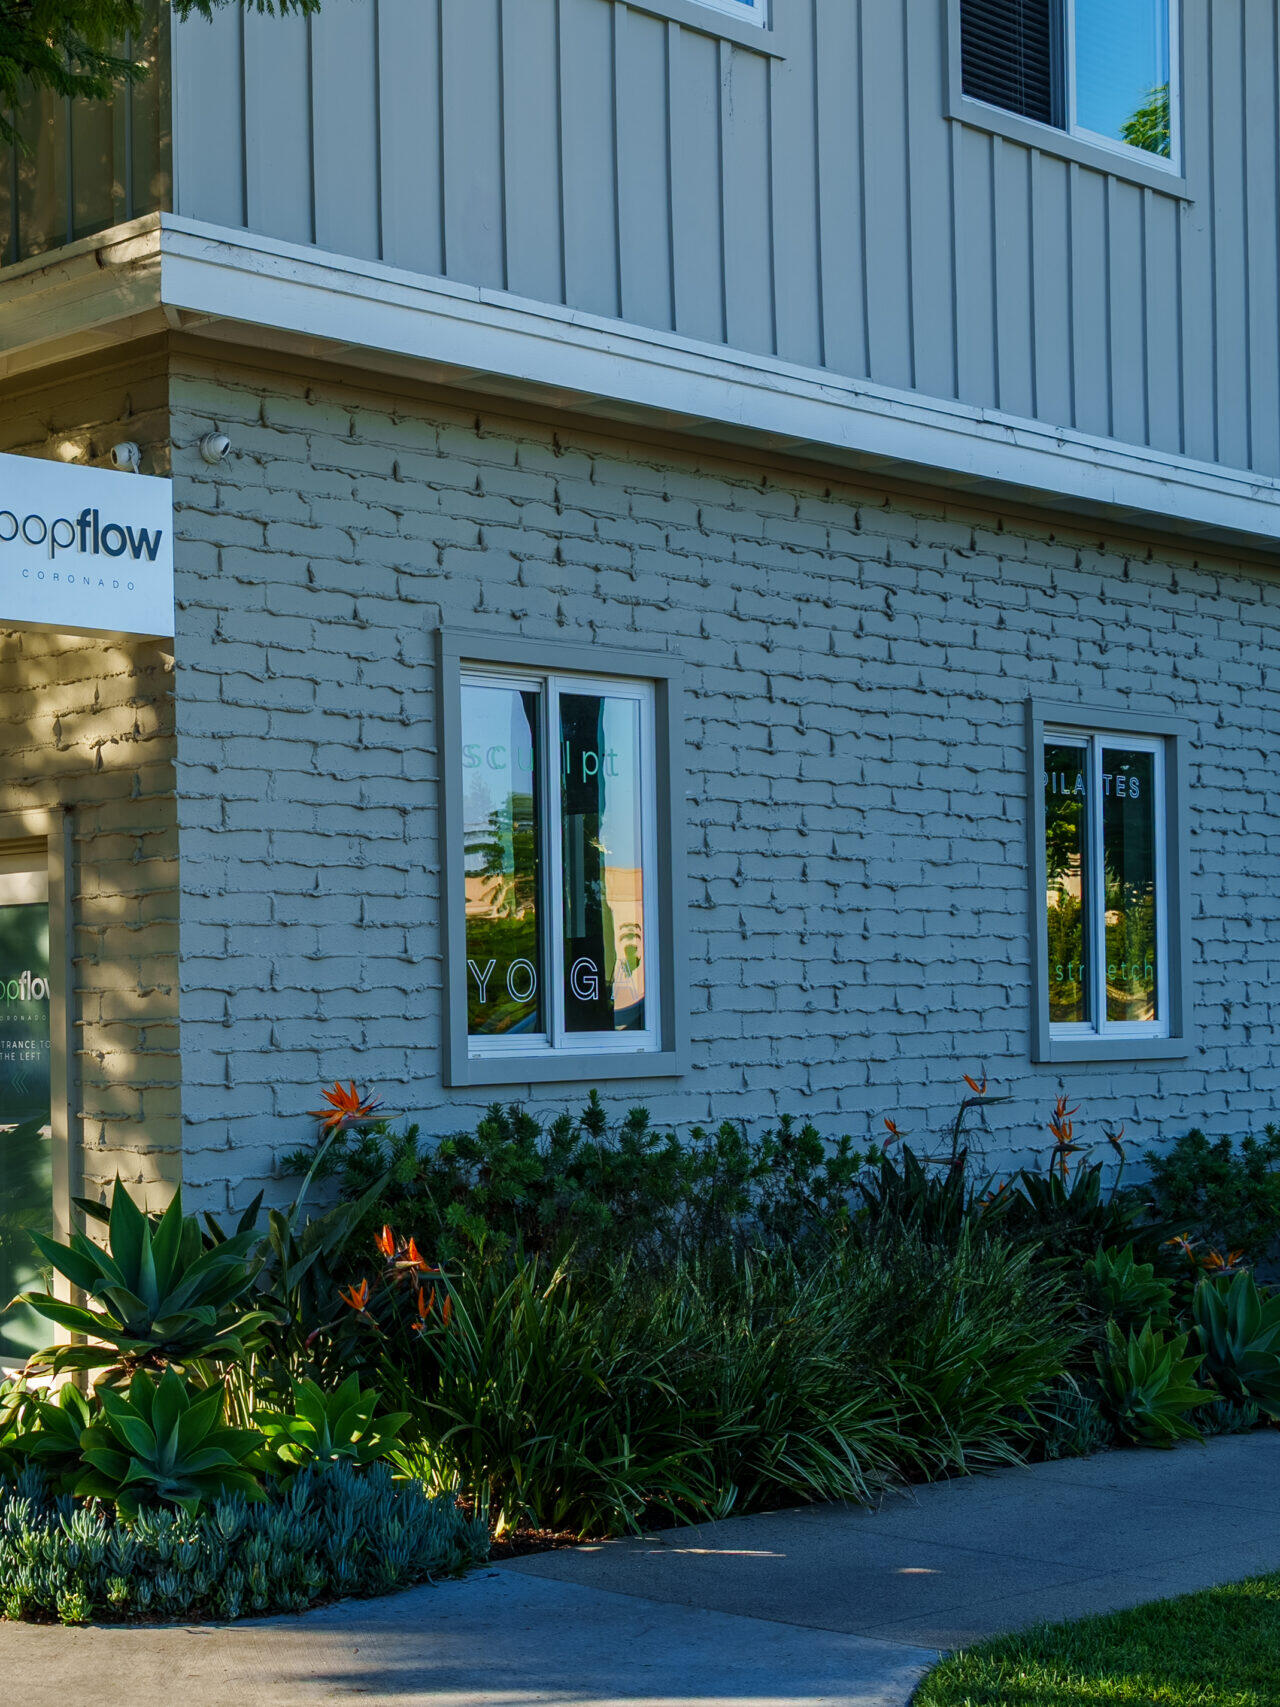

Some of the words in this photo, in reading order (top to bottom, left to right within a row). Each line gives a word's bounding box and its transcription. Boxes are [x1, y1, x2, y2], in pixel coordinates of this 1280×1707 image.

[22, 569, 136, 591] CORONADO
[462, 740, 619, 783] sculpt
[467, 957, 639, 1003] YOGA
[1056, 956, 1153, 981] stretch
[0, 1052, 16, 1061] THE
[19, 1052, 41, 1061] LEFT
